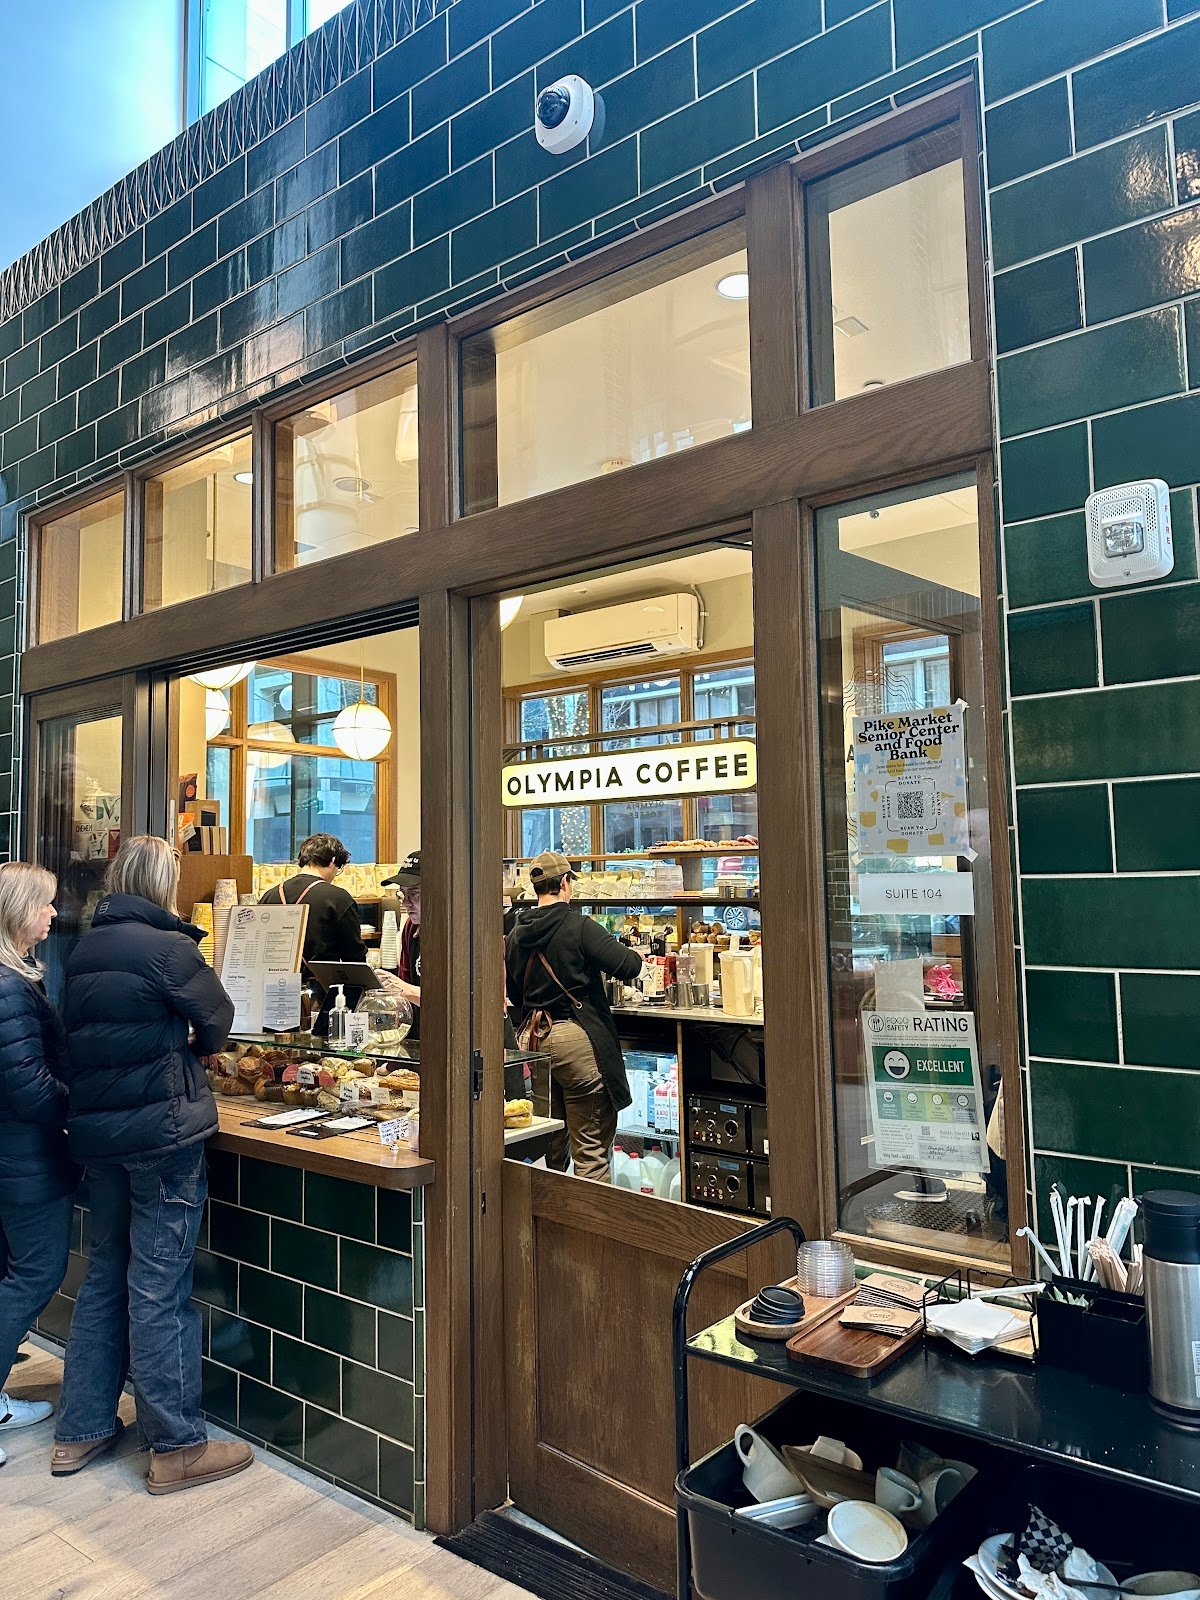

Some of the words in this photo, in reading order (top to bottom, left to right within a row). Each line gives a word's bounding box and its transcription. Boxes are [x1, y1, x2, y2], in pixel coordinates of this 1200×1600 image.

[864, 719, 894, 733] Pike
[898, 712, 952, 728] Market
[859, 730, 905, 743] Senior
[909, 724, 959, 738] Center
[875, 739, 902, 751] and
[905, 734, 943, 748] Food
[890, 748, 928, 760] Bank
[507, 766, 623, 796] OLYMPIA
[636, 753, 748, 784] COFFEE
[885, 889, 918, 899] SUITE
[922, 889, 942, 899] 104
[913, 1017, 968, 1032] RATING
[916, 1060, 964, 1072] EXCELLENT
